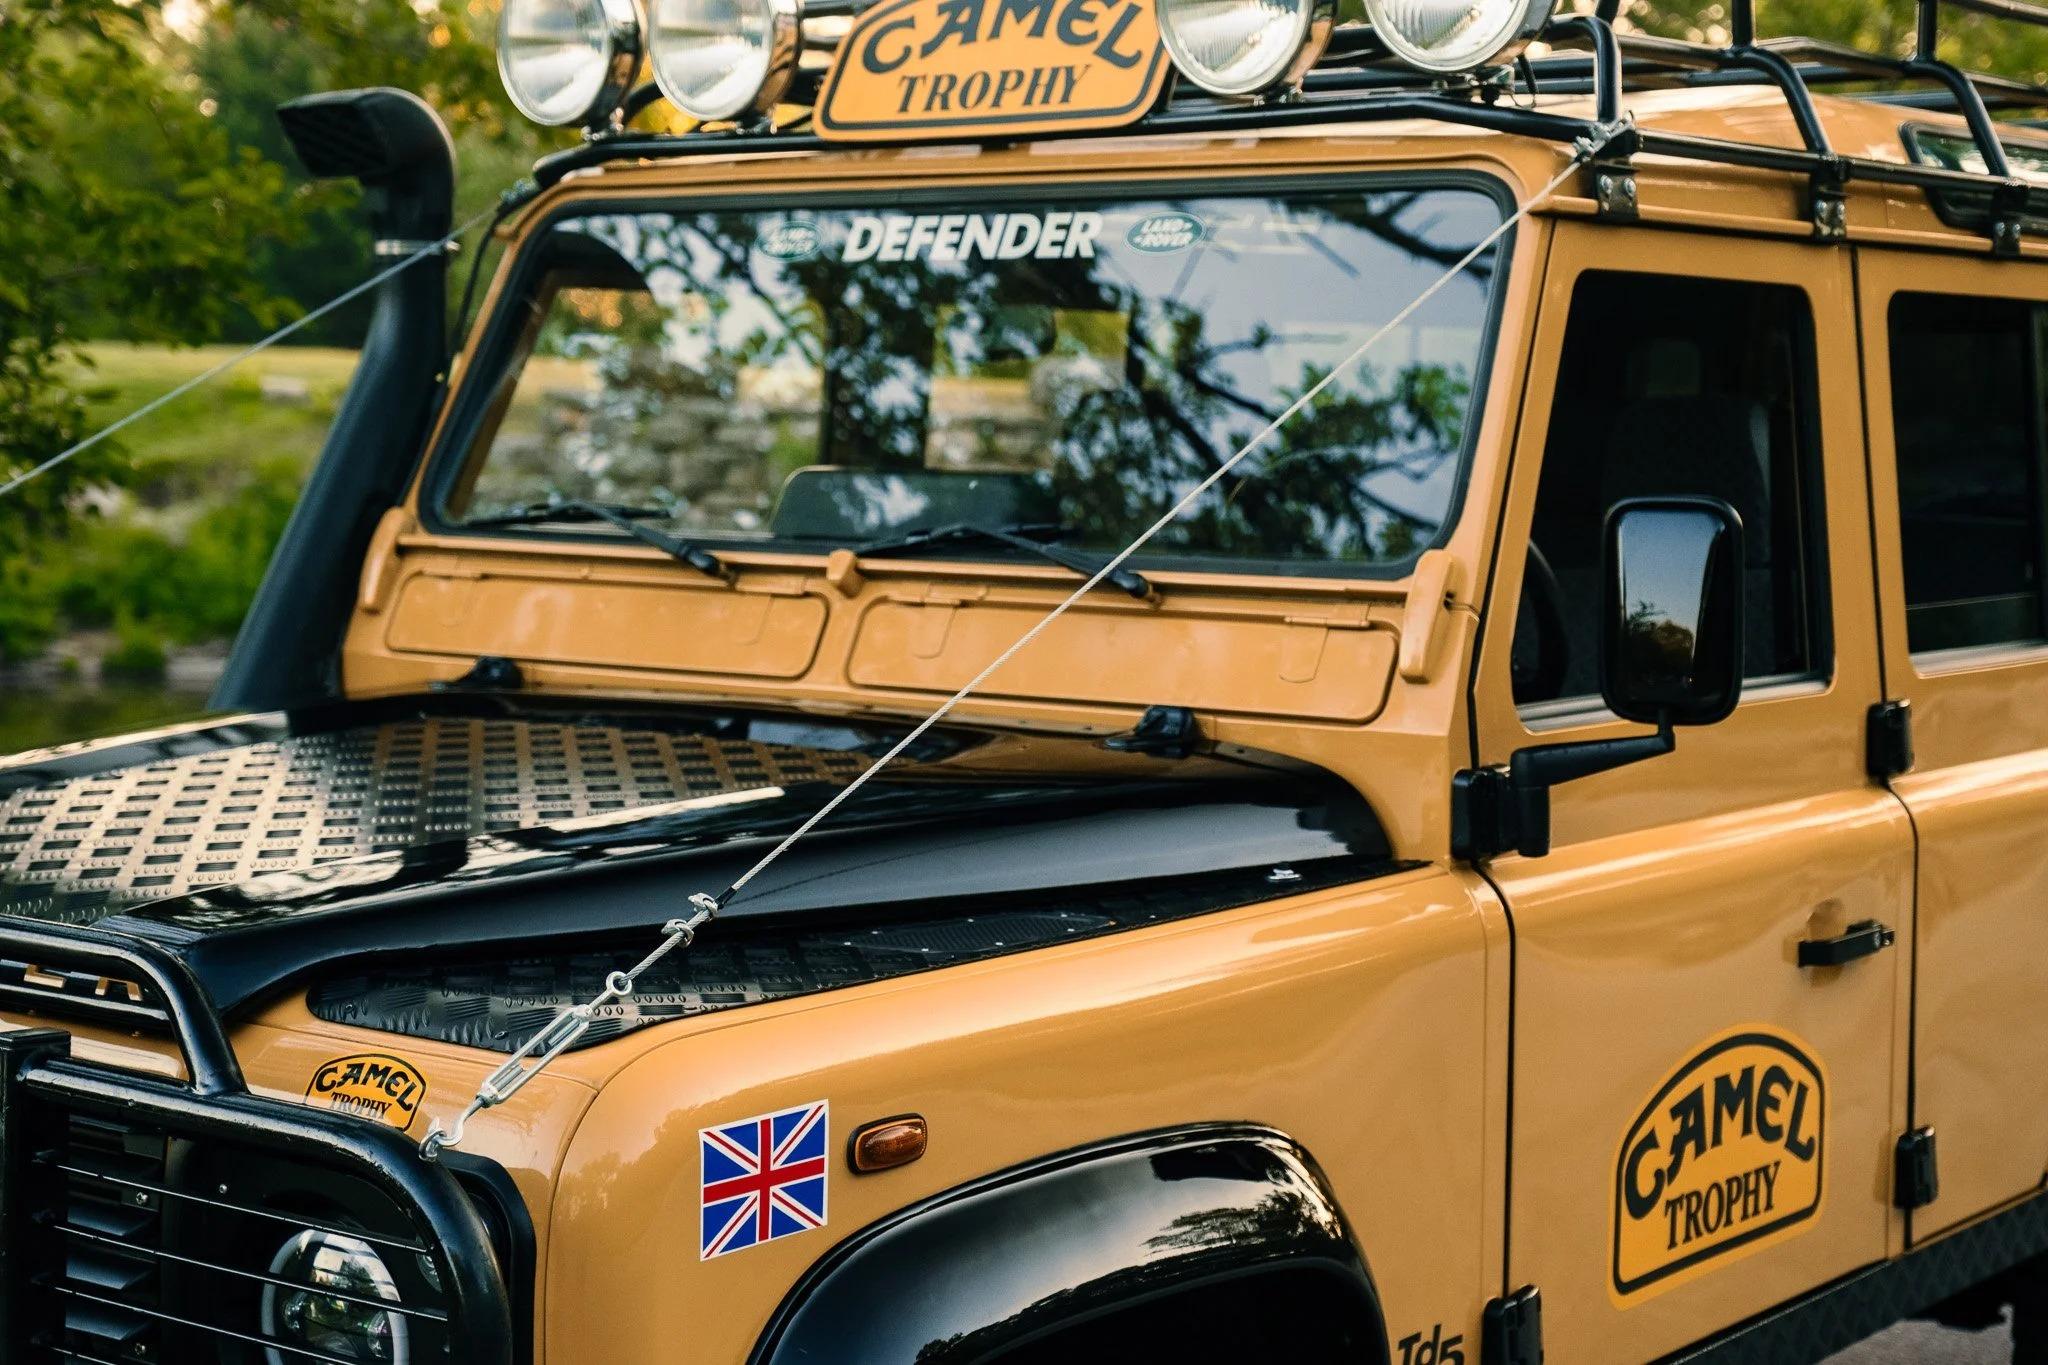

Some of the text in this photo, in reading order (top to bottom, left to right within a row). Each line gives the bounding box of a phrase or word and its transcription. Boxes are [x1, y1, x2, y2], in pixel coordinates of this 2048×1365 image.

[862, 0, 1143, 73] CAMEL
[897, 64, 1091, 114] TROPHY
[841, 211, 1101, 262] DEFENDER
[315, 1062, 417, 1112] CAMEL
[330, 1092, 393, 1119] TROPHY
[1624, 1064, 1816, 1221] CAMEL
[1664, 1161, 1781, 1250] TROPHY
[1398, 1323, 1465, 1365] Td5
